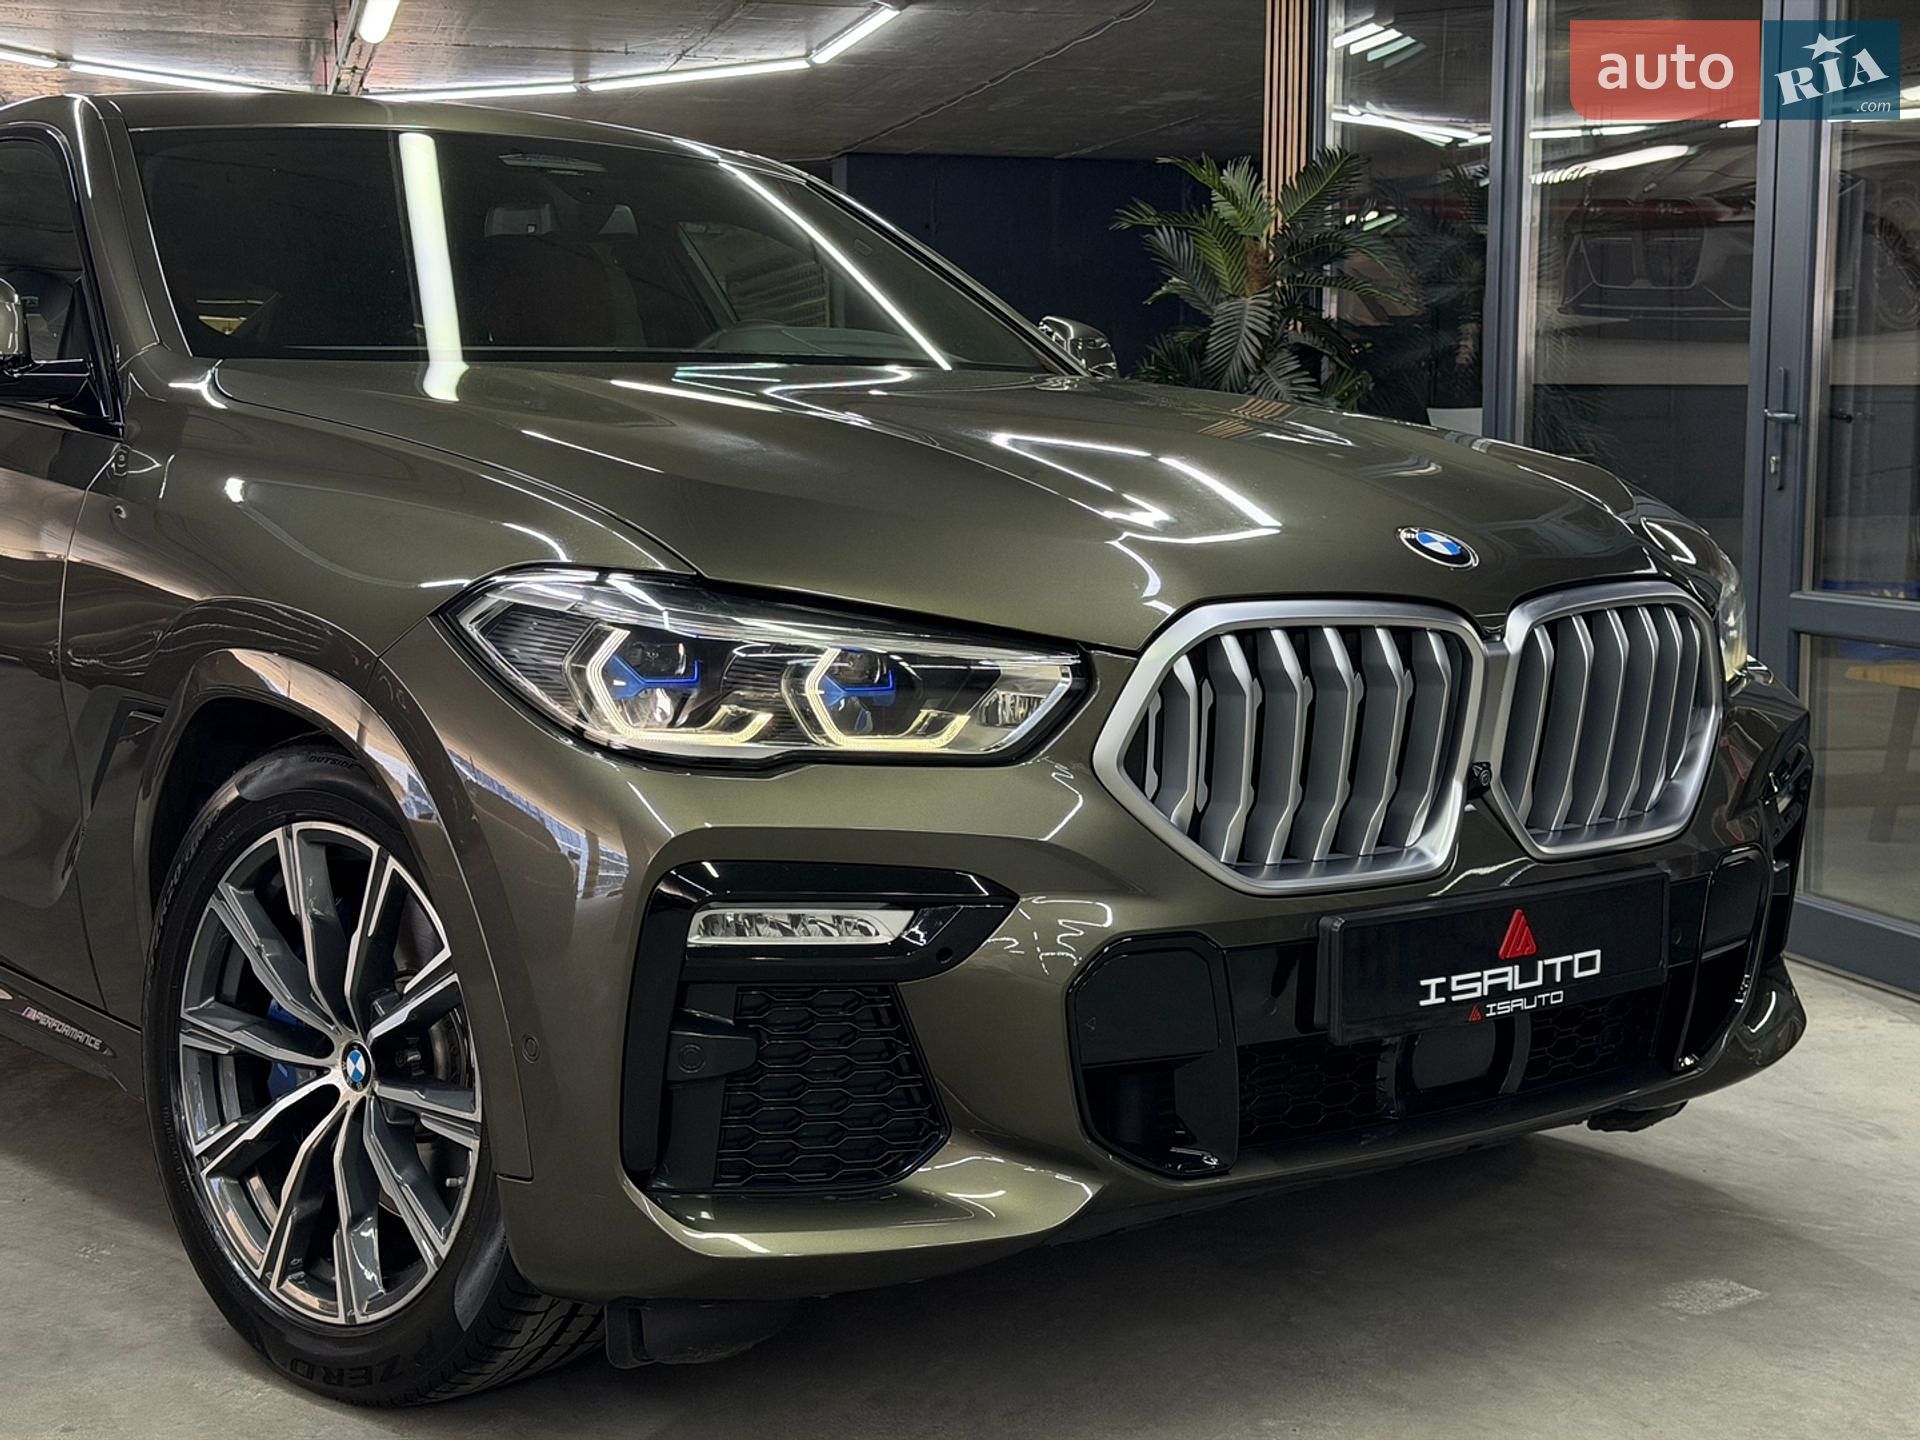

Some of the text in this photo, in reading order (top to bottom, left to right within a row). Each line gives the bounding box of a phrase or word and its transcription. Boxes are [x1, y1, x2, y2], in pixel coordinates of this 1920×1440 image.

[1419, 949, 1601, 1007] ISAUTO
[1485, 990, 1564, 1017] ISAUTO
[290, 1354, 402, 1388] ZERO
